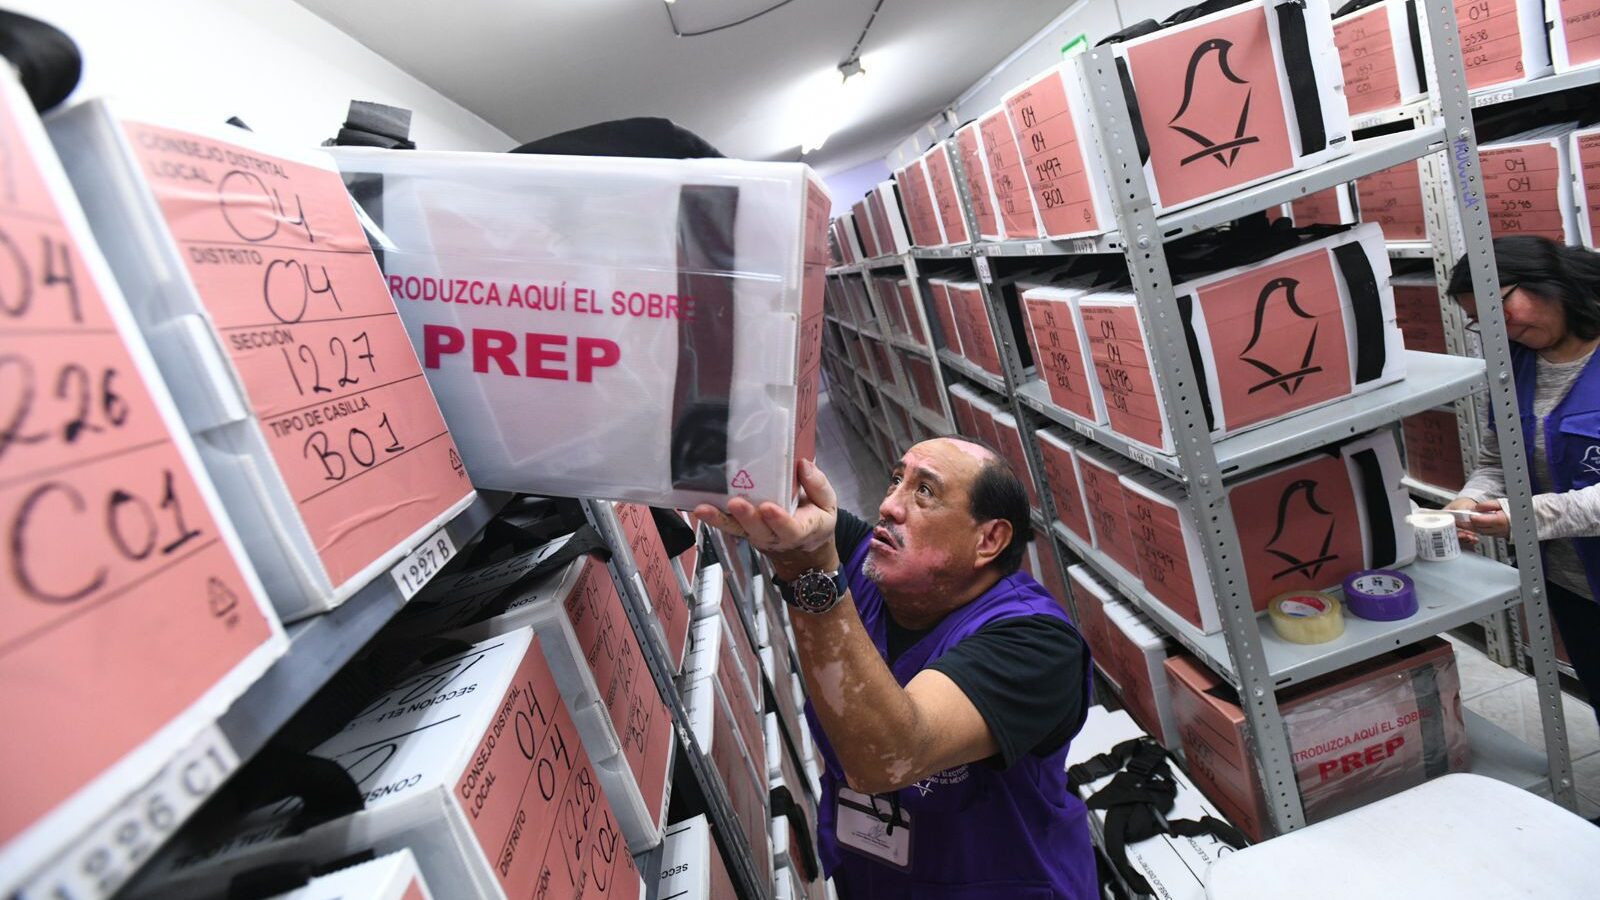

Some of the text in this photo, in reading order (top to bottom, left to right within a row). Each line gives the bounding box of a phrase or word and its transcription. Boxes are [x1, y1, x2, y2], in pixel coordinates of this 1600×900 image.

[1022, 106, 1038, 127] 04
[136, 131, 290, 180] CONSEJO DISTRITAL
[1032, 131, 1046, 152] 04
[1505, 157, 1527, 172] 04
[151, 161, 214, 184] LOCAL
[1036, 157, 1061, 181] 1497
[1507, 176, 1531, 191] 04
[218, 170, 315, 243] 04
[1042, 188, 1064, 208] B01
[189, 247, 263, 266] DISTRITO
[264, 259, 343, 324] 04
[384, 275, 696, 321] RODUZCA AQUÍ EL SOBRE
[230, 327, 295, 350] SECCIÓN
[423, 324, 620, 383] PREP
[1101, 320, 1116, 340] 04
[1107, 342, 1122, 365] 04
[281, 331, 376, 395] 1227
[269, 396, 370, 438] TIPO DE CASILLA
[304, 412, 404, 481] B01
[11, 468, 201, 605] C01
[401, 552, 438, 593] 1227
[437, 538, 451, 560] B
[409, 683, 478, 713] SECCIÓN
[515, 681, 547, 760] 04
[461, 686, 521, 800] CONSEJO DISTRITAL
[1353, 722, 1379, 743] AQUÍ
[1382, 722, 1395, 733] EL
[537, 724, 571, 801] 04
[1318, 735, 1405, 783] PREP
[470, 771, 496, 820] LOCAL
[500, 810, 527, 878] DISTRITO
[559, 767, 596, 887] 1228
[592, 810, 618, 892] C01
